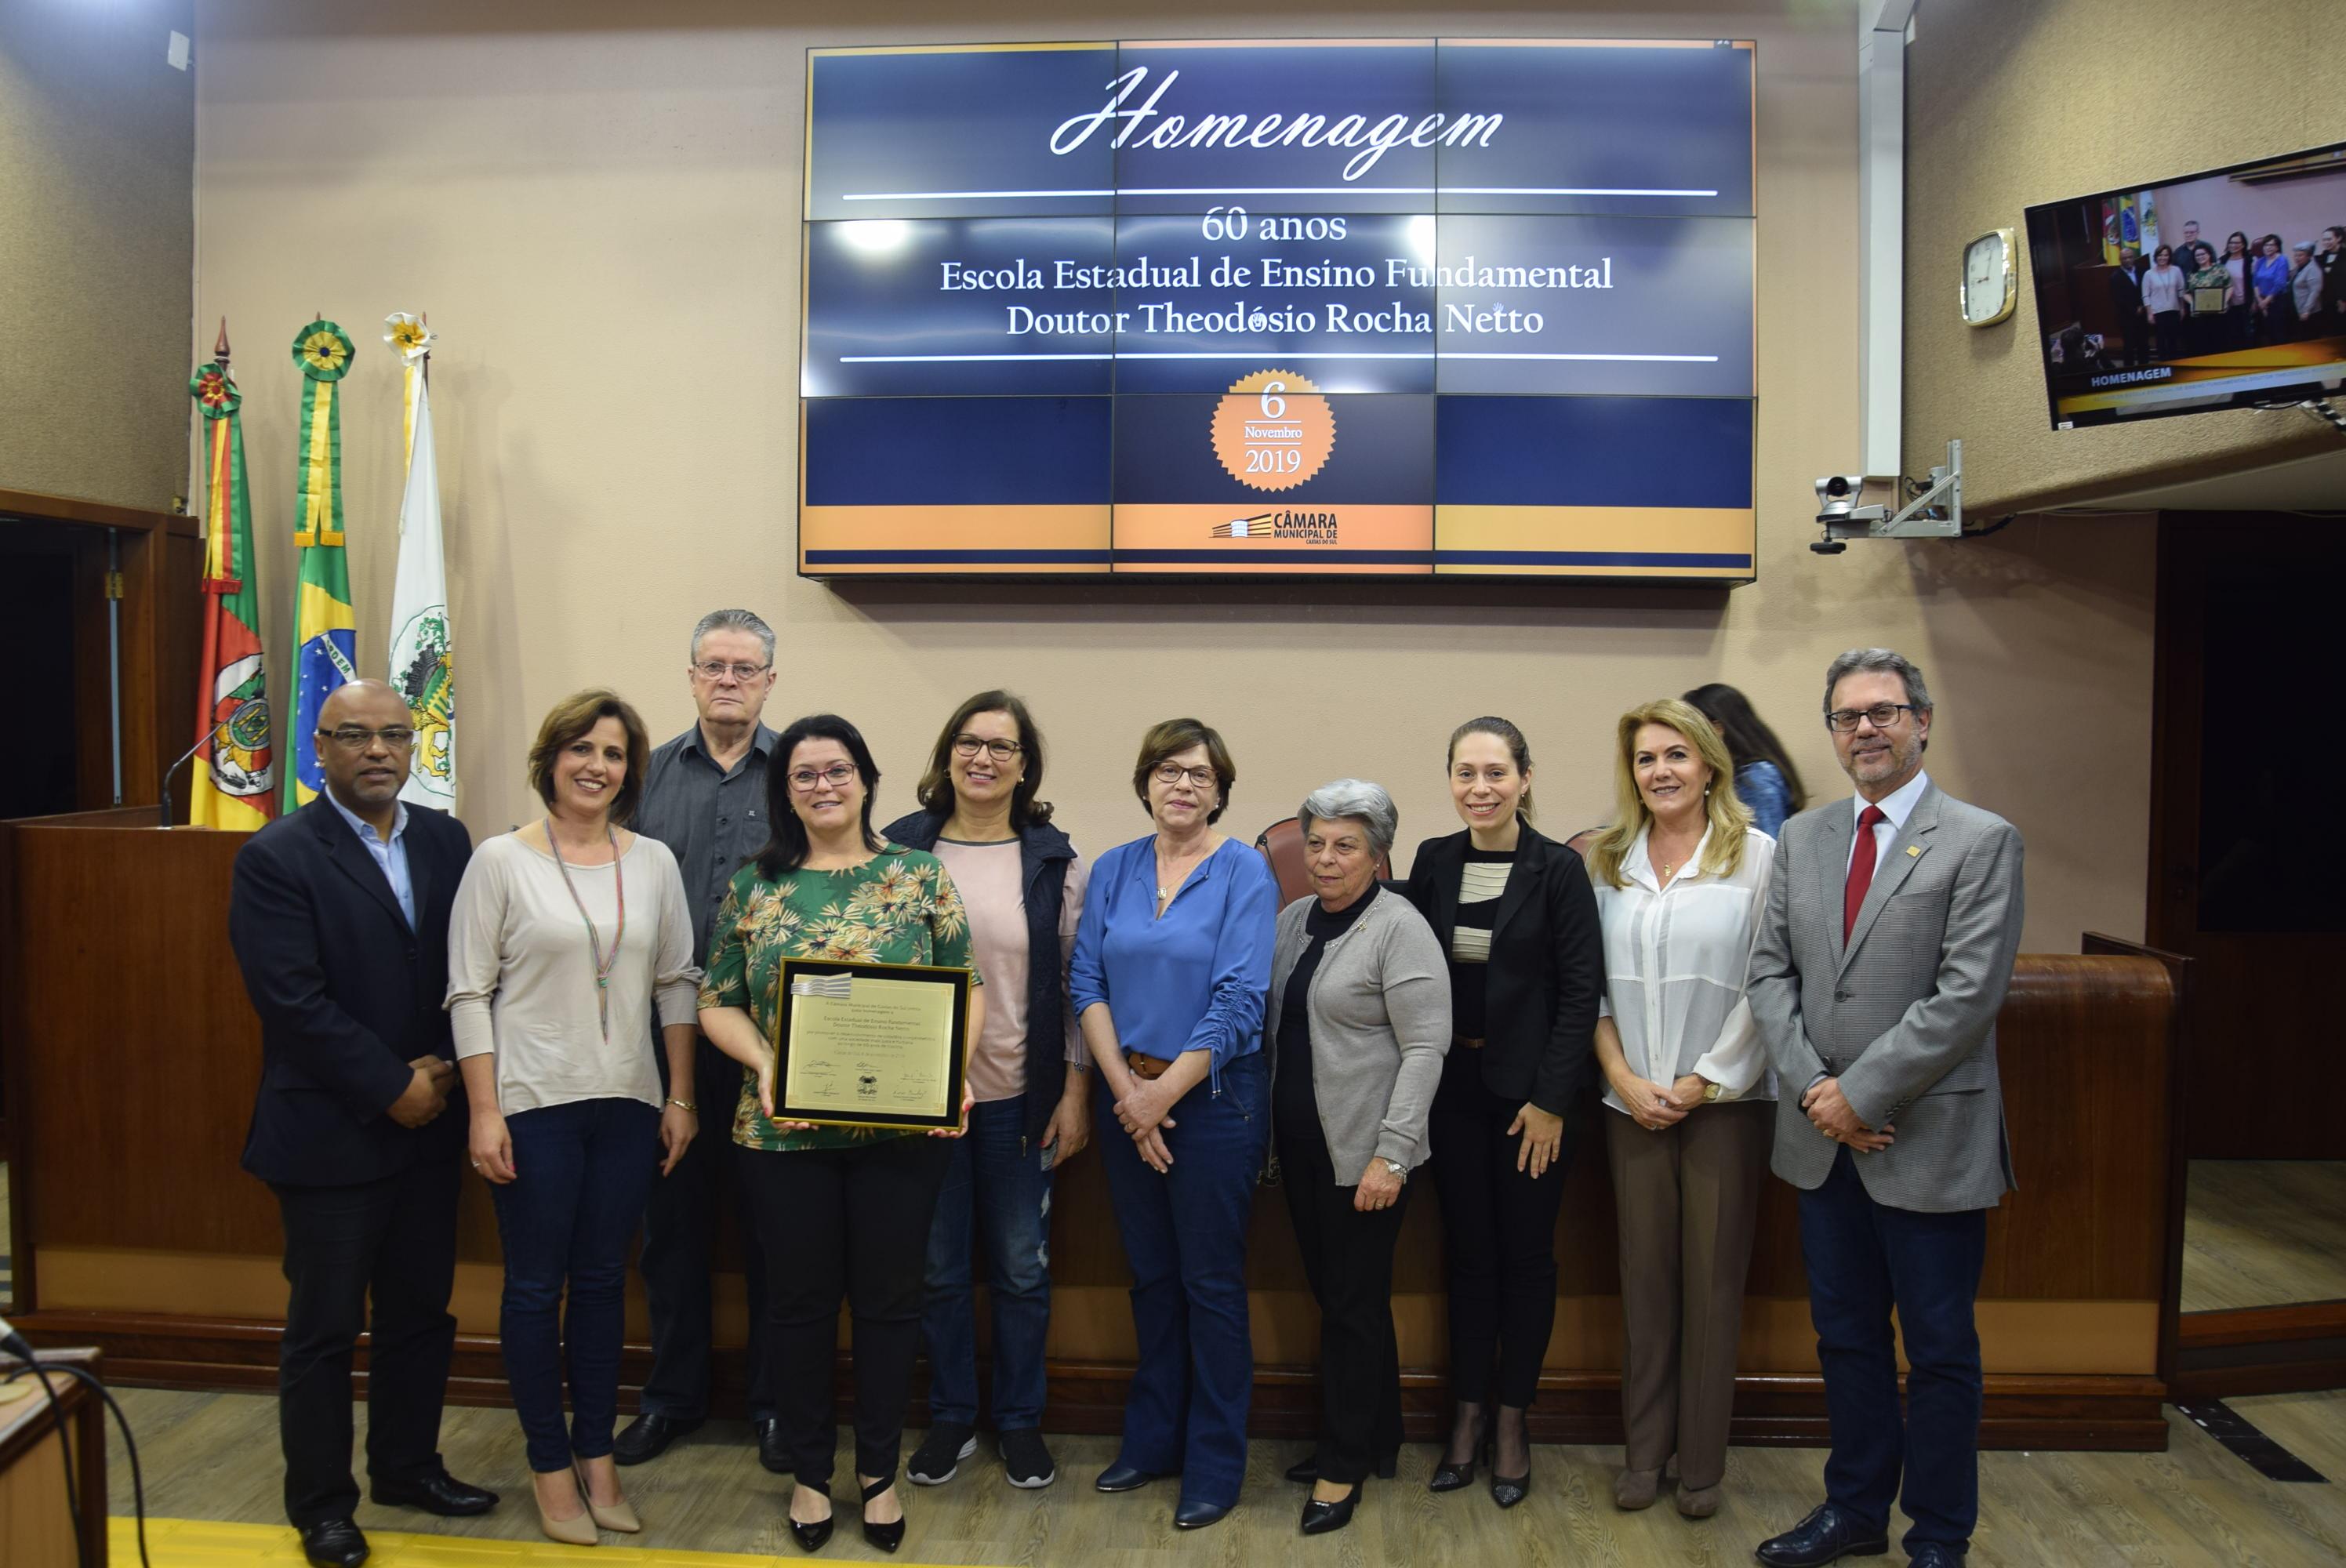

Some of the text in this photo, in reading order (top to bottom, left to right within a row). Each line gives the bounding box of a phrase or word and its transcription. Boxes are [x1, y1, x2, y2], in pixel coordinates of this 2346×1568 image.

[1050, 67, 1503, 181] Homenagem
[1201, 206, 1347, 241] 60 anos
[940, 256, 1614, 290] Escola Estadual de Ensino Fundamental
[1007, 301, 1544, 335] Doutor Theodósio Rocha Netto
[2091, 367, 2172, 387] HOMENAGEM
[1261, 381, 1286, 419] 6
[1244, 426, 1302, 438] Novembro
[1245, 449, 1301, 474] 2019
[1274, 510, 1338, 528] CÂMARA
[1274, 529, 1338, 539] MUNICIPAL DE
